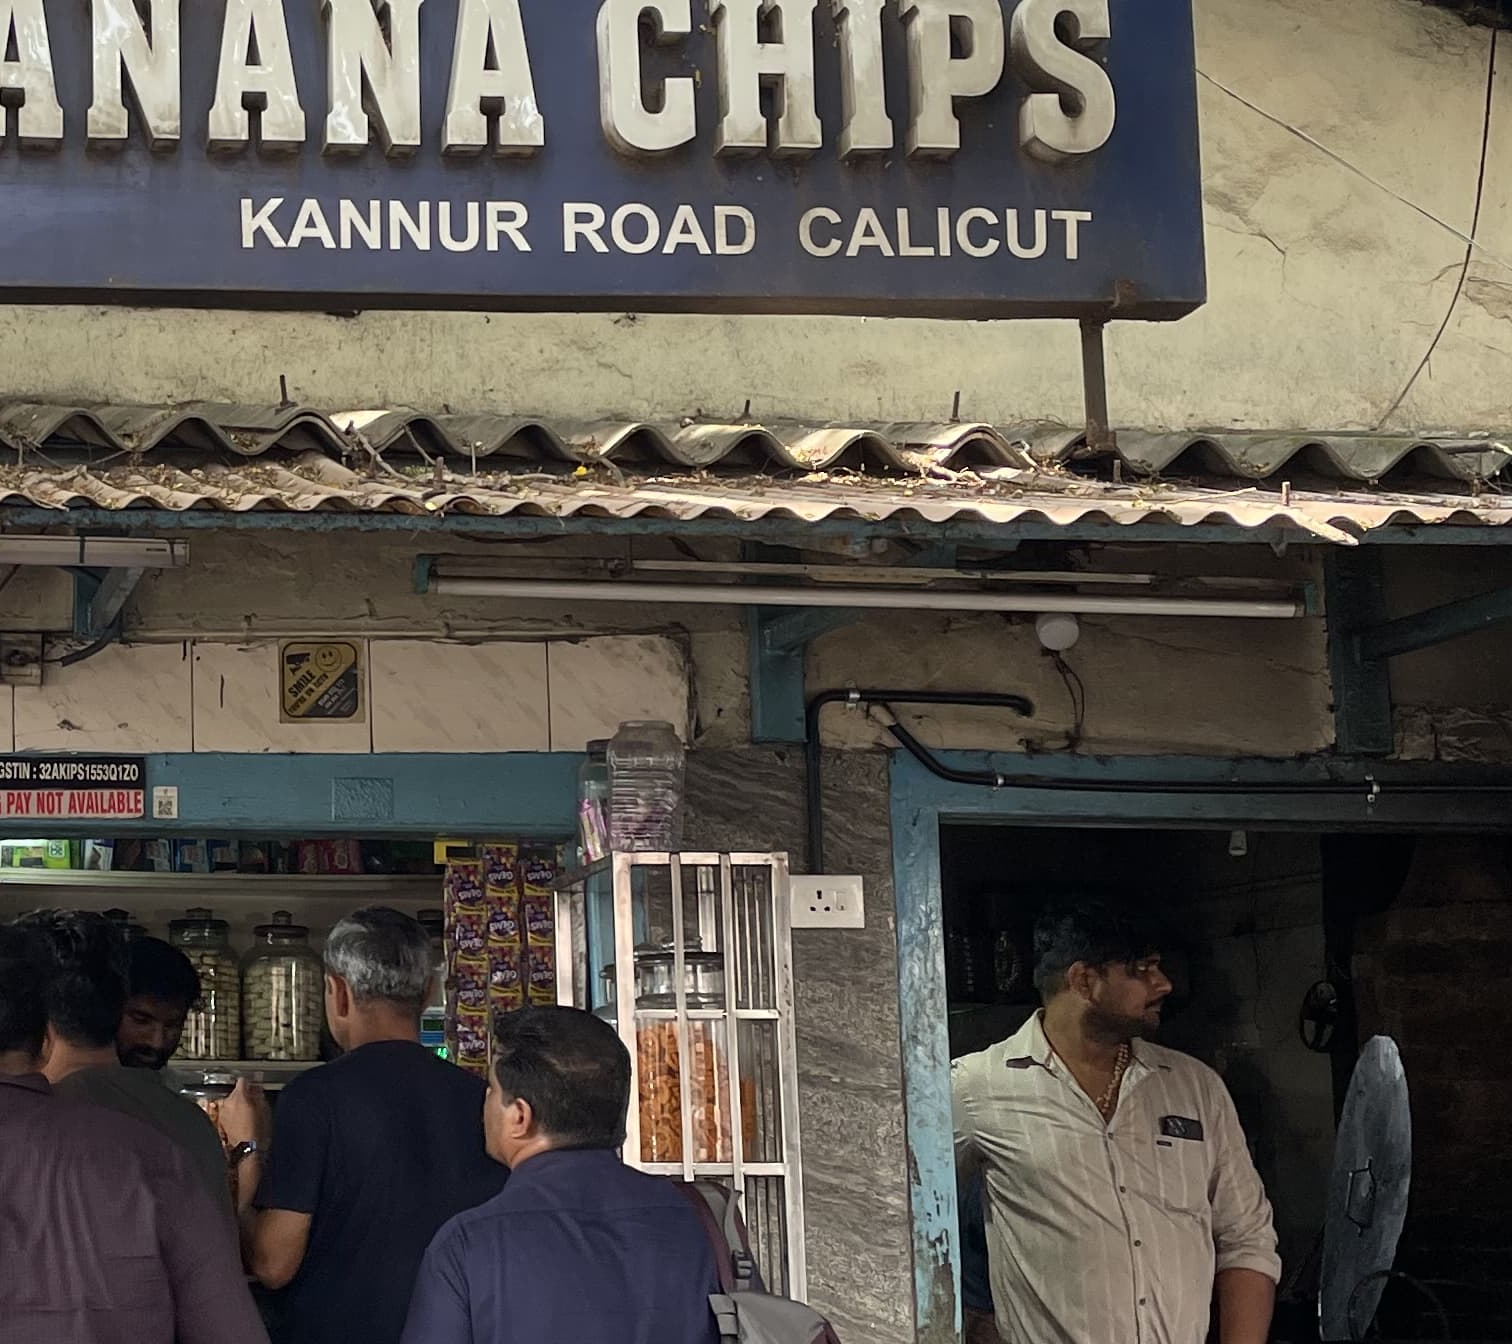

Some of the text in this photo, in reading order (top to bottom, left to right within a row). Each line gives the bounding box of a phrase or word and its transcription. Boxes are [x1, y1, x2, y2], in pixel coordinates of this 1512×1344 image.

[239, 197, 1093, 260] KANNUR ROAD CALICUT
[288, 669, 316, 698] SMILE
[6, 791, 32, 814] PAY
[36, 791, 64, 815] NOT
[67, 791, 142, 814] AVAILABLE
